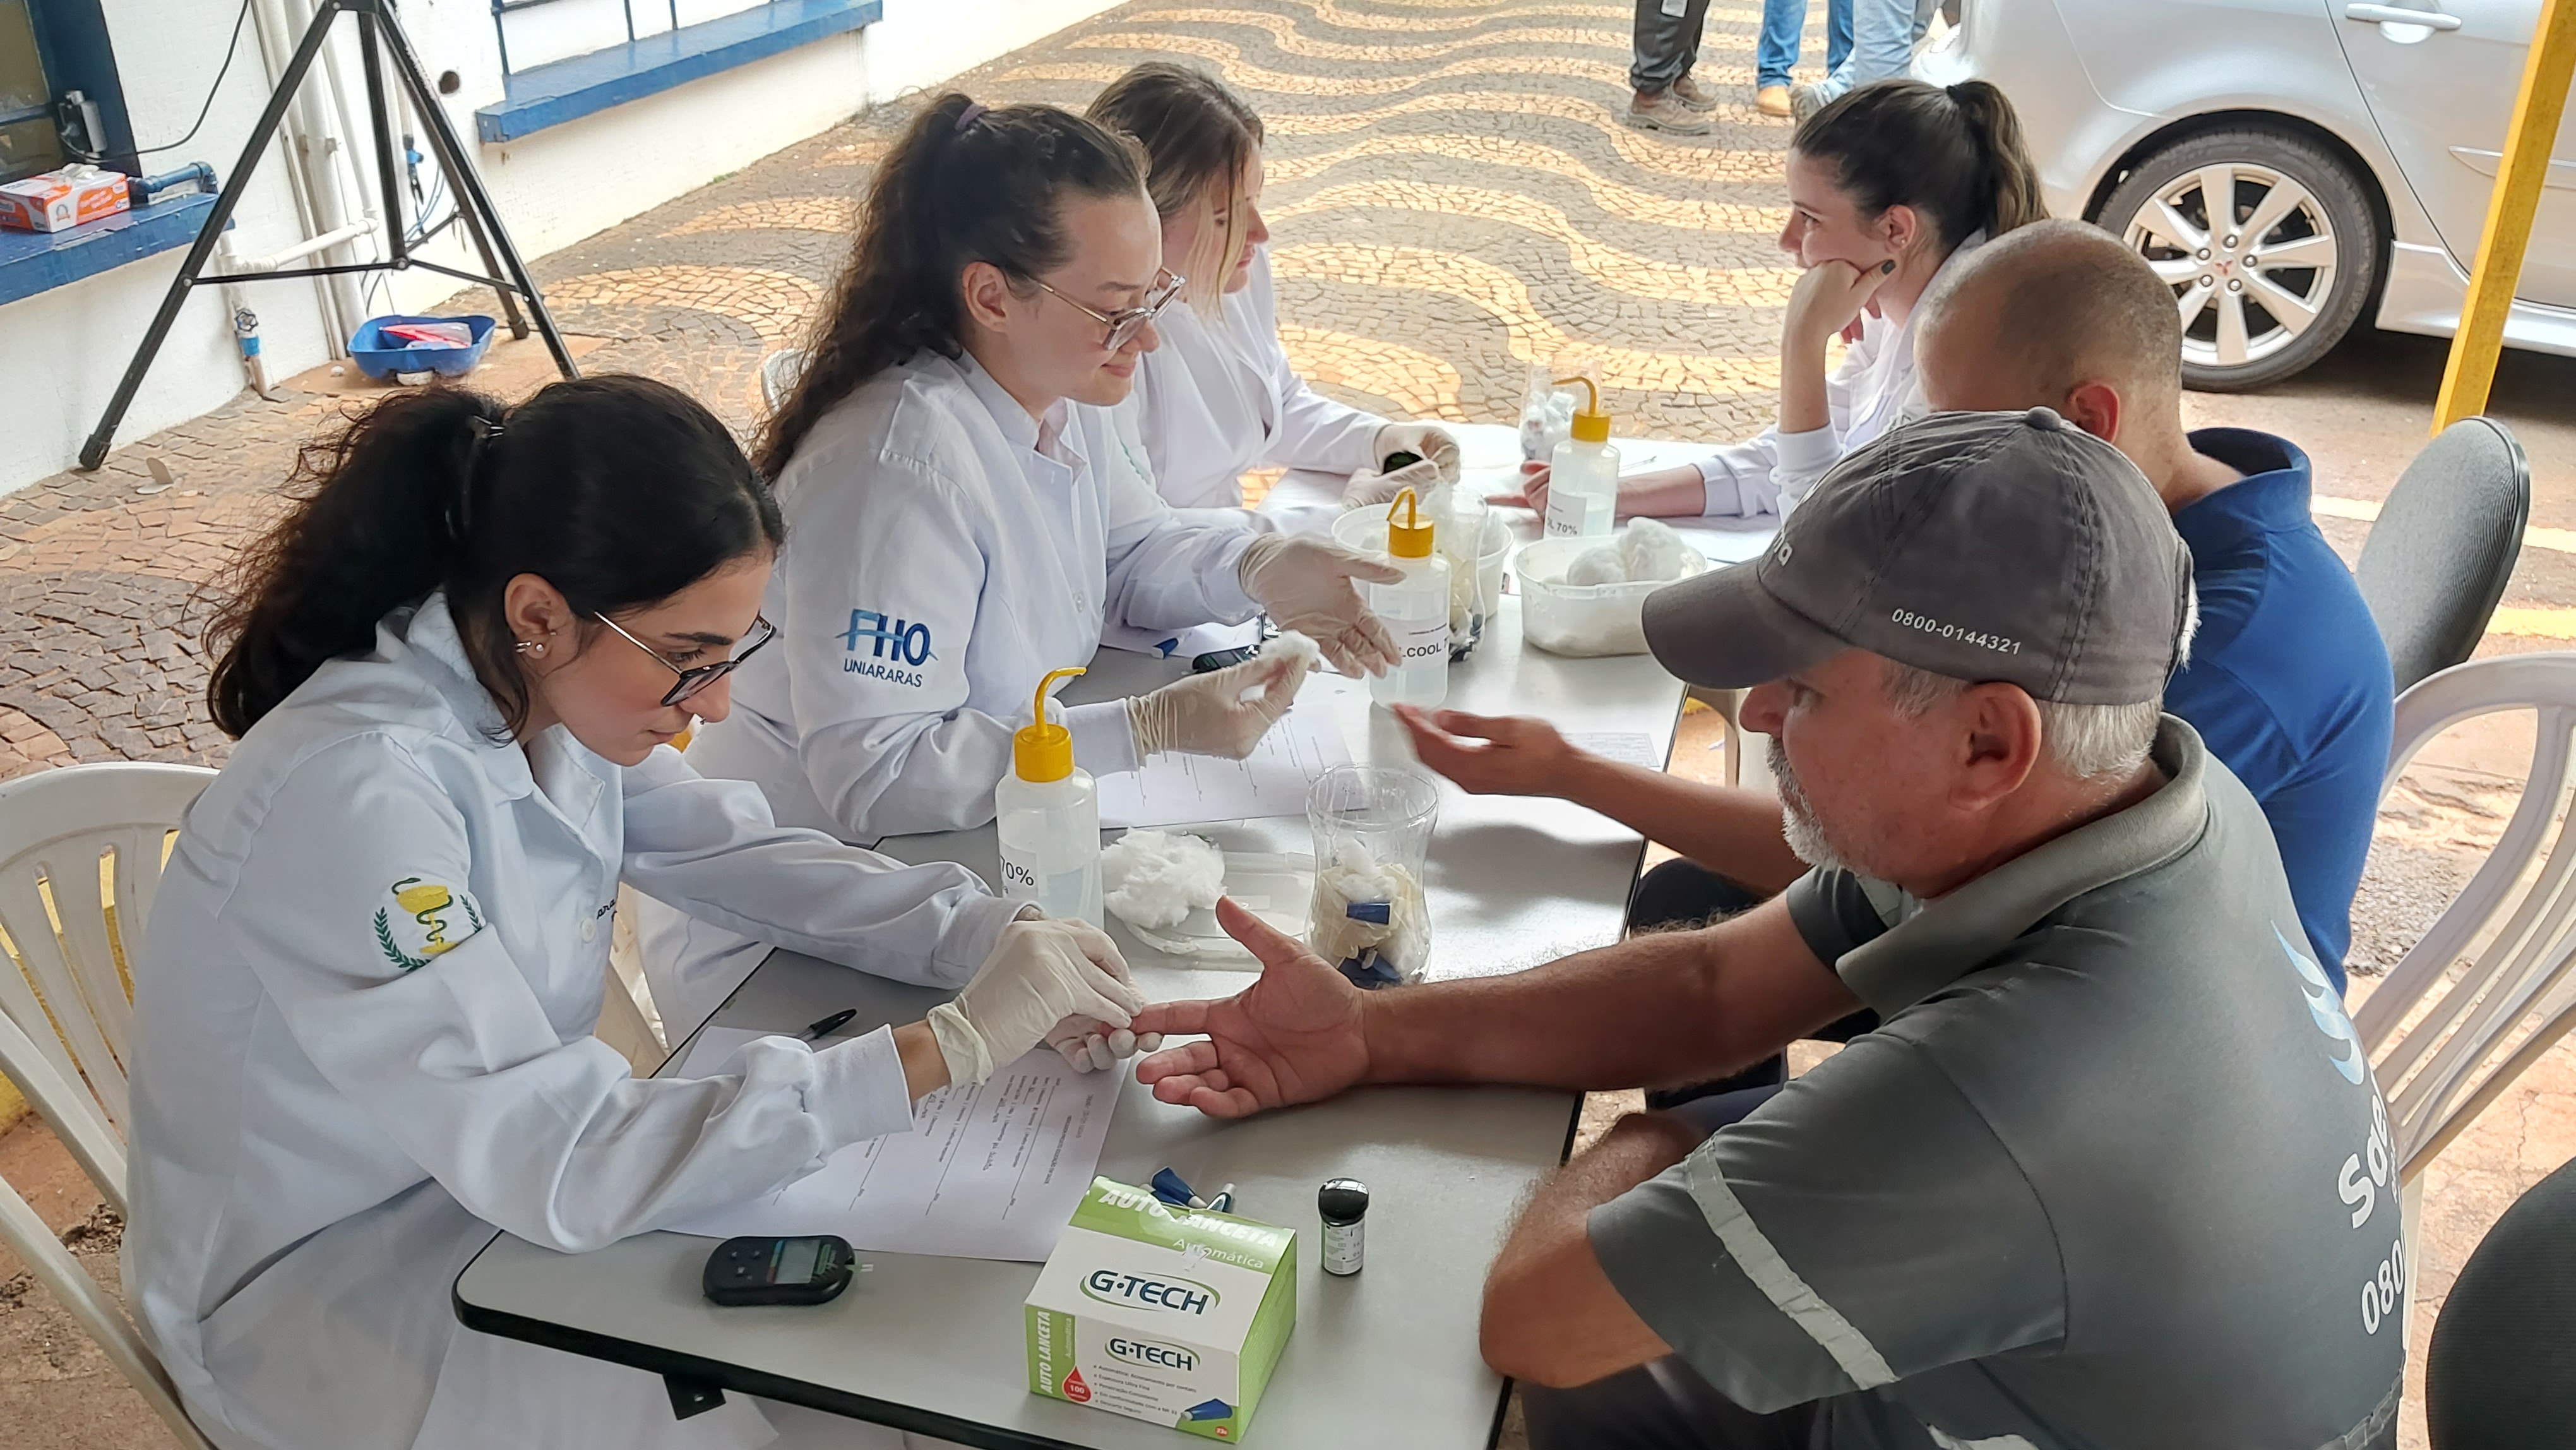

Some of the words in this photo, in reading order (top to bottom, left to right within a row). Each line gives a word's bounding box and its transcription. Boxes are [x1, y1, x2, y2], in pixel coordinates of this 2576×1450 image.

[1557, 522, 1577, 536] 70%
[1892, 608, 2020, 655] 0800-0144321
[1398, 643, 1441, 657] COOL
[844, 658, 922, 688] UNIARARAS
[1098, 1190, 1168, 1217] AUTO
[2362, 1239, 2404, 1334] 080
[1037, 1311, 1051, 1362] LANCETA
[1039, 1362, 1052, 1394] AUTO
[1070, 1385, 1085, 1394] 100
